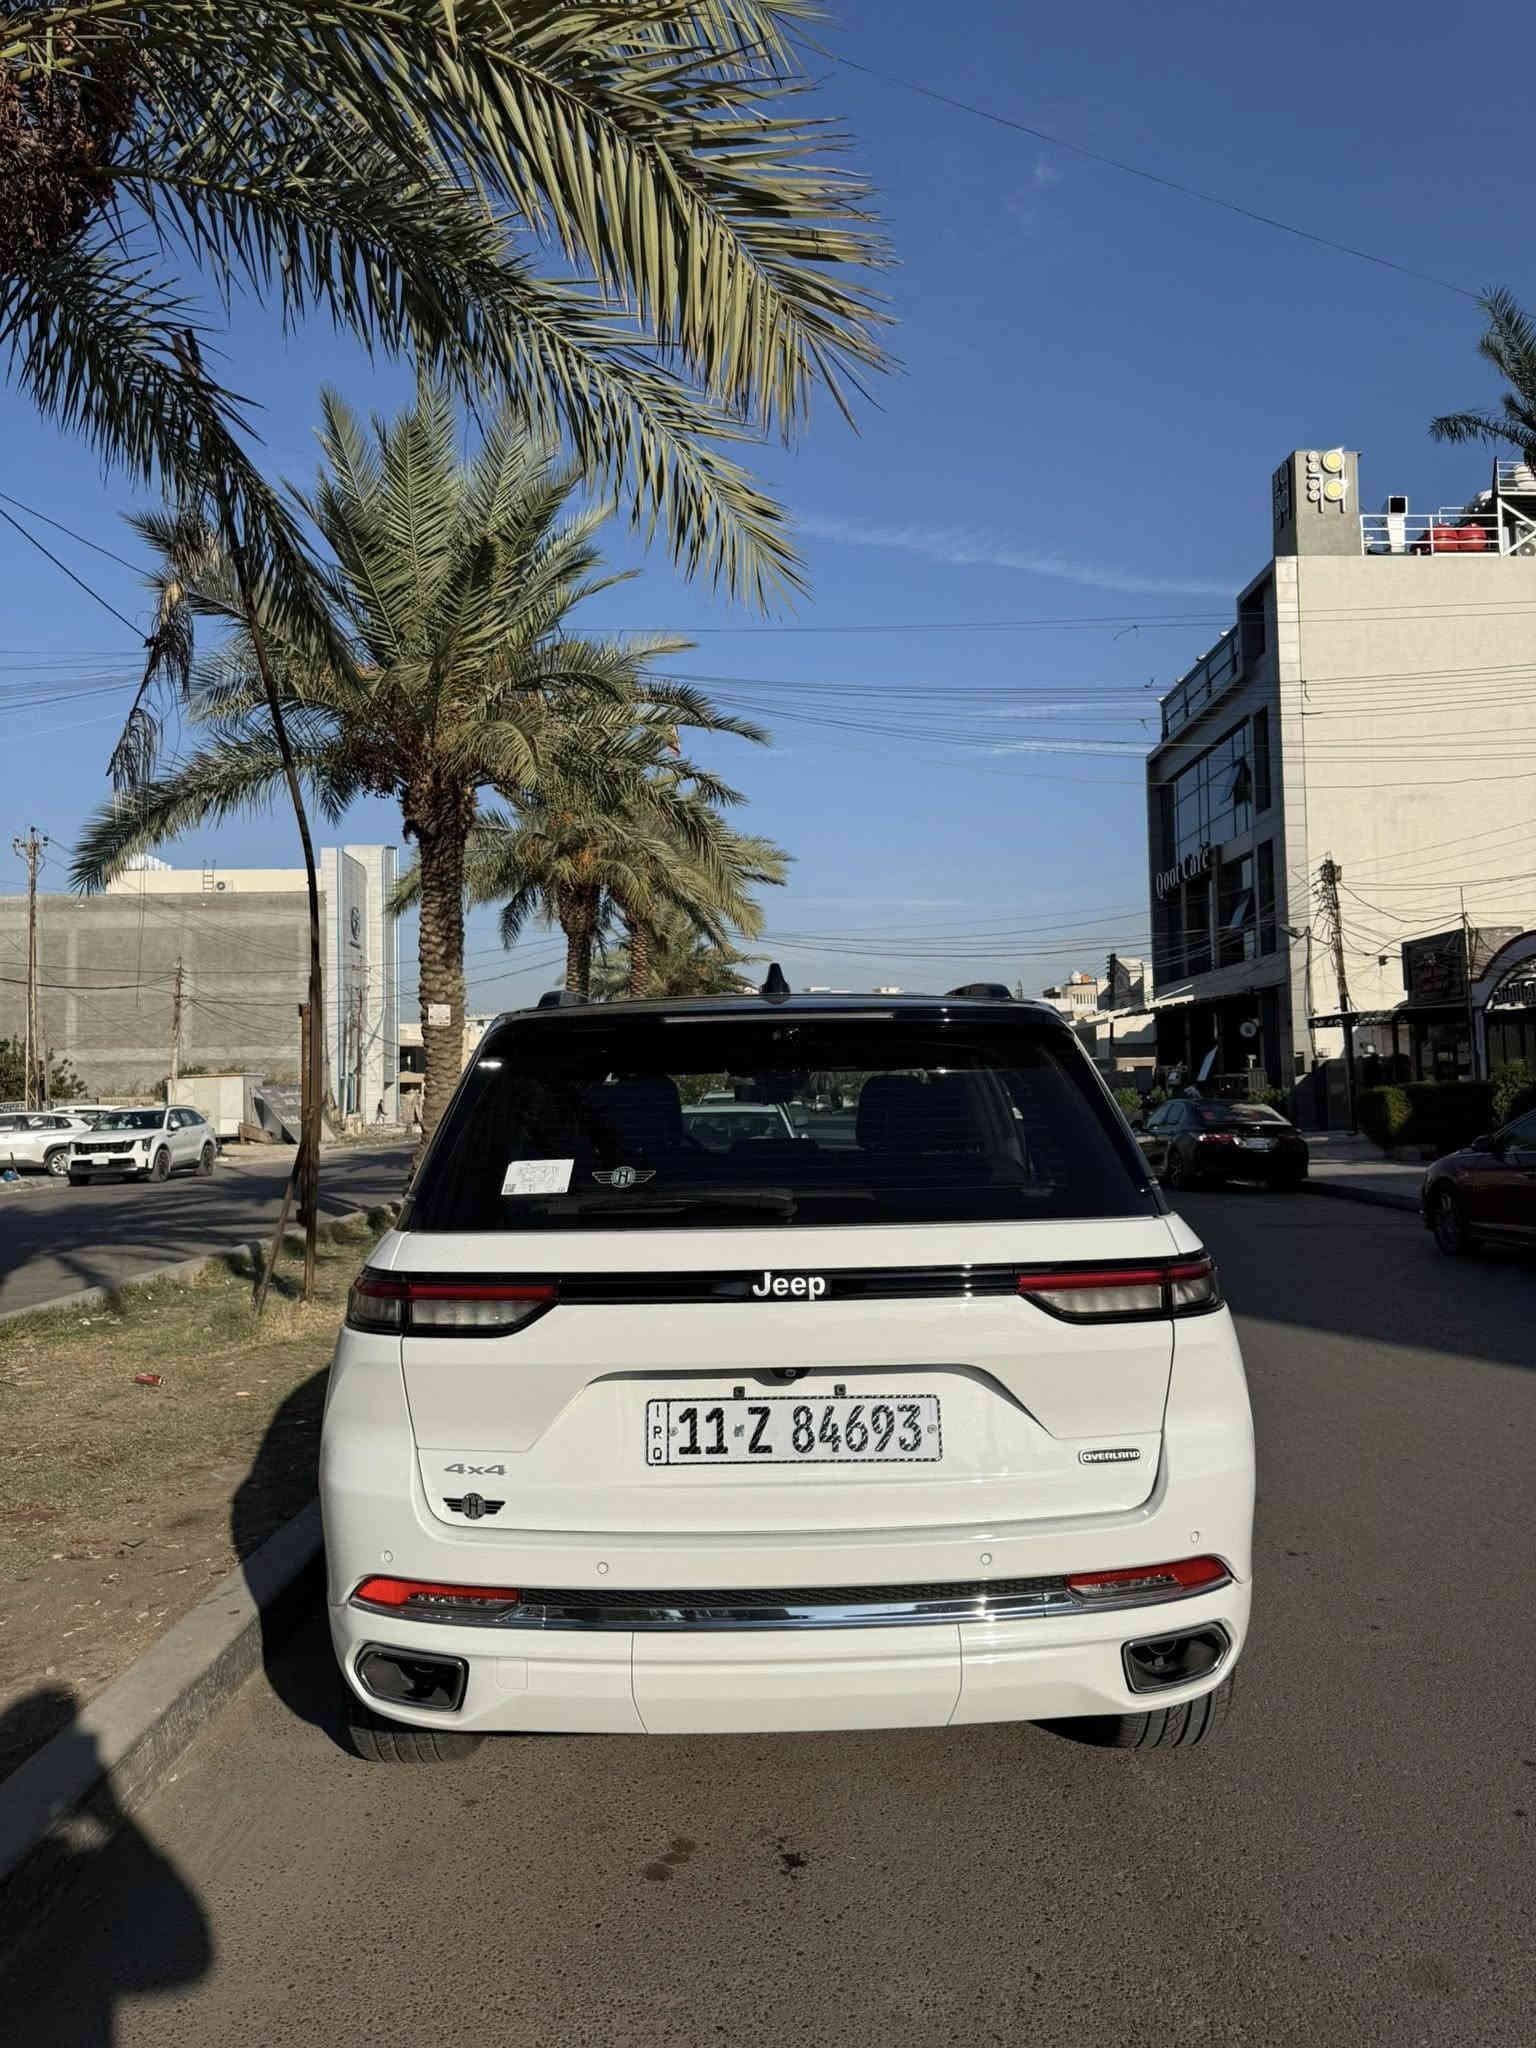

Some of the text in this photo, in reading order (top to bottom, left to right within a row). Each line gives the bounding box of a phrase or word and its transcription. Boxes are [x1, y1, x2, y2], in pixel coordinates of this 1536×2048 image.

[752, 1272, 826, 1301] Jeep
[653, 1404, 663, 1460] IRQ
[678, 1404, 922, 1455] 11 Z 84693
[1083, 1450, 1140, 1462] OVERLAND
